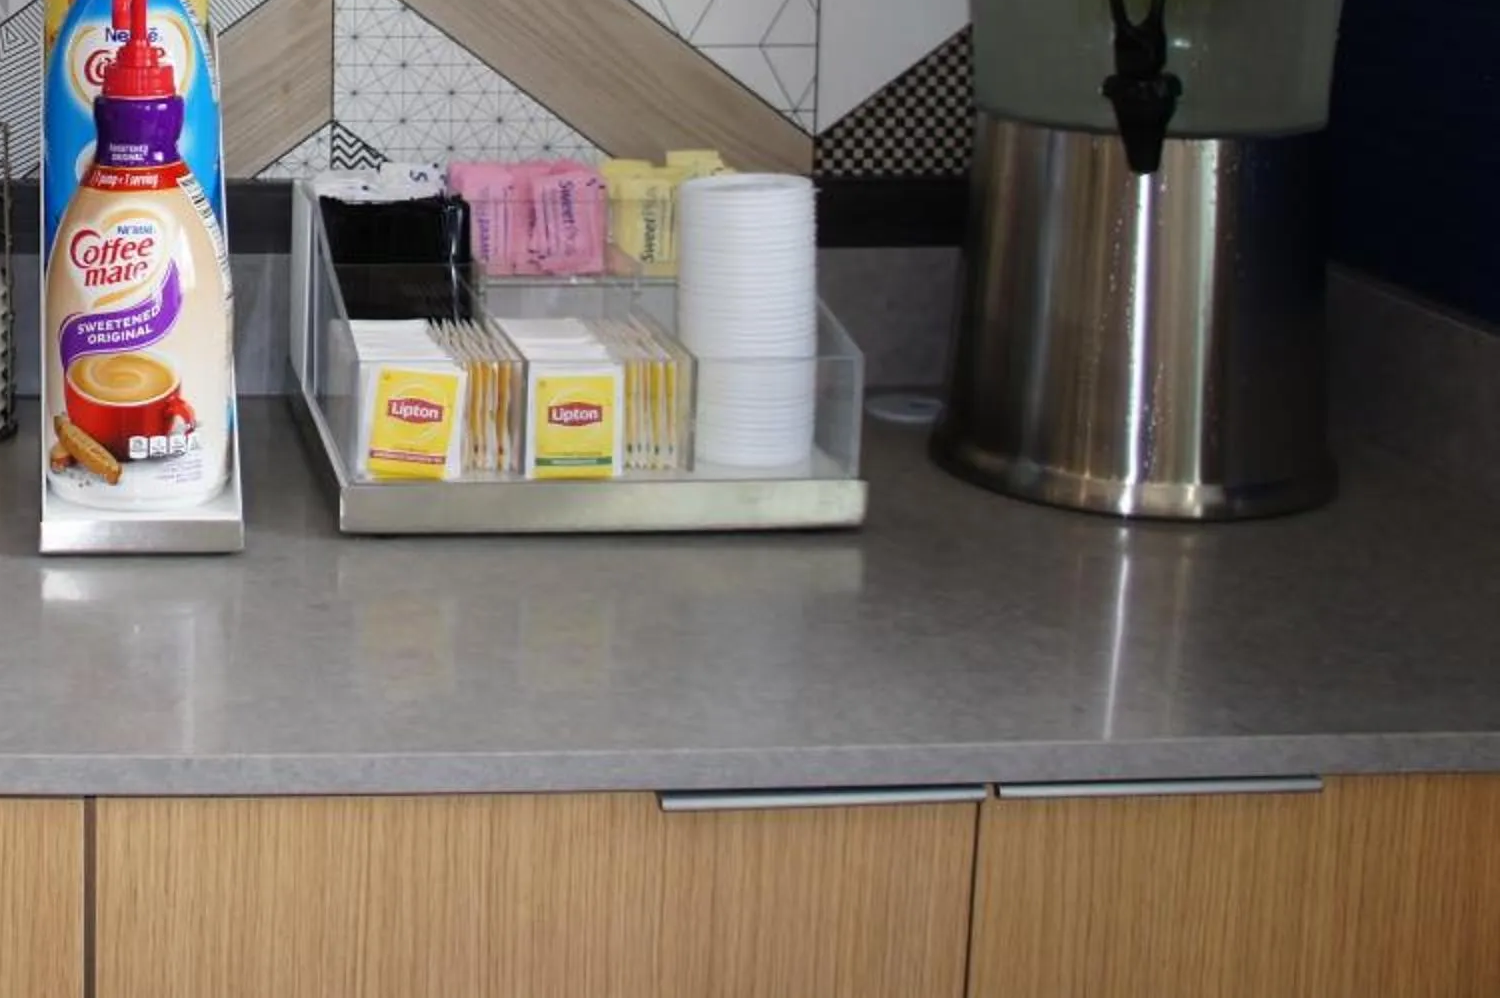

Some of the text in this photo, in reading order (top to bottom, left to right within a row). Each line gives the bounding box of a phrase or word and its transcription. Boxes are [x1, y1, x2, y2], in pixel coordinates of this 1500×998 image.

[70, 229, 155, 269] Coffee
[84, 260, 149, 287] mate
[76, 305, 161, 336] SWEETENED
[87, 326, 153, 345] ORIGINAL
[391, 402, 440, 421] Lipton
[551, 407, 599, 422] Lipton
